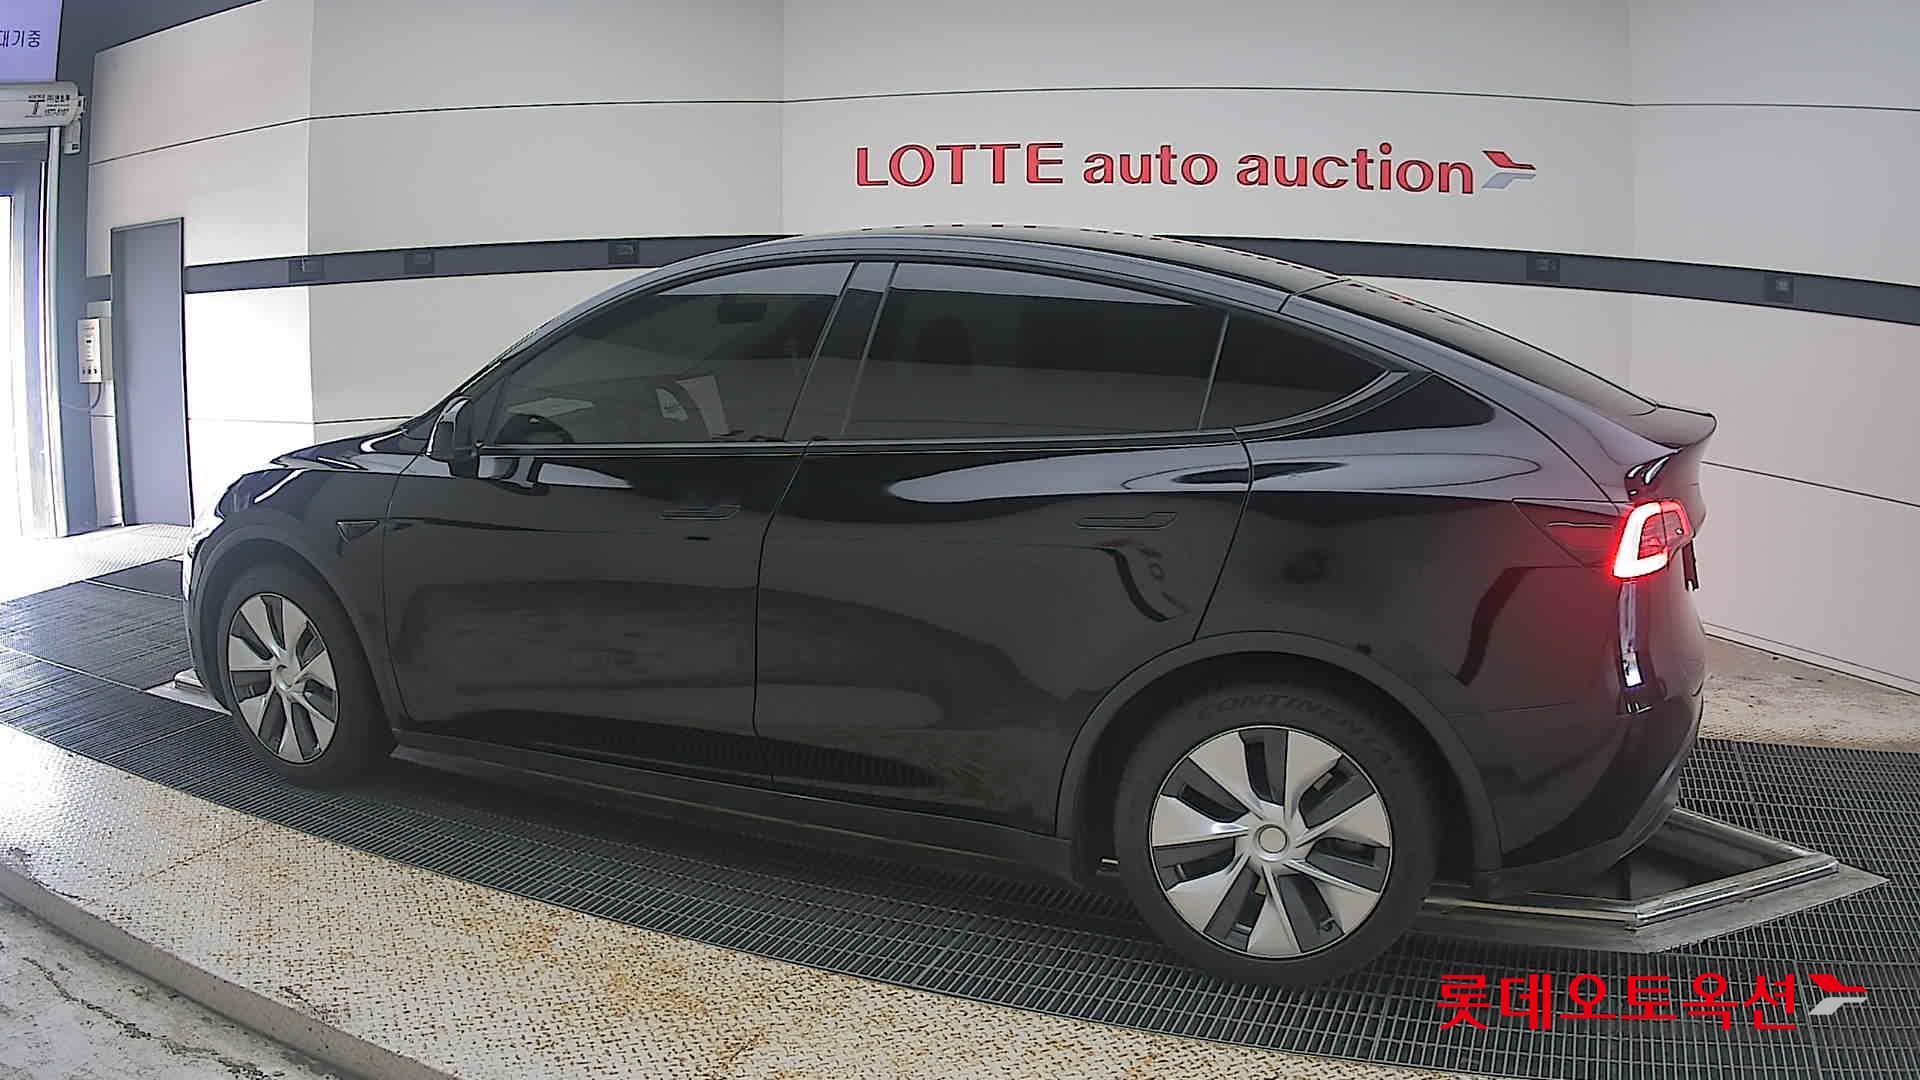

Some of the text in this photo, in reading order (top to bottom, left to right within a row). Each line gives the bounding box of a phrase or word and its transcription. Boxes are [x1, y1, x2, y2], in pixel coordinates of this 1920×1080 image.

[857, 143, 1474, 194] LOTTE auto auction
